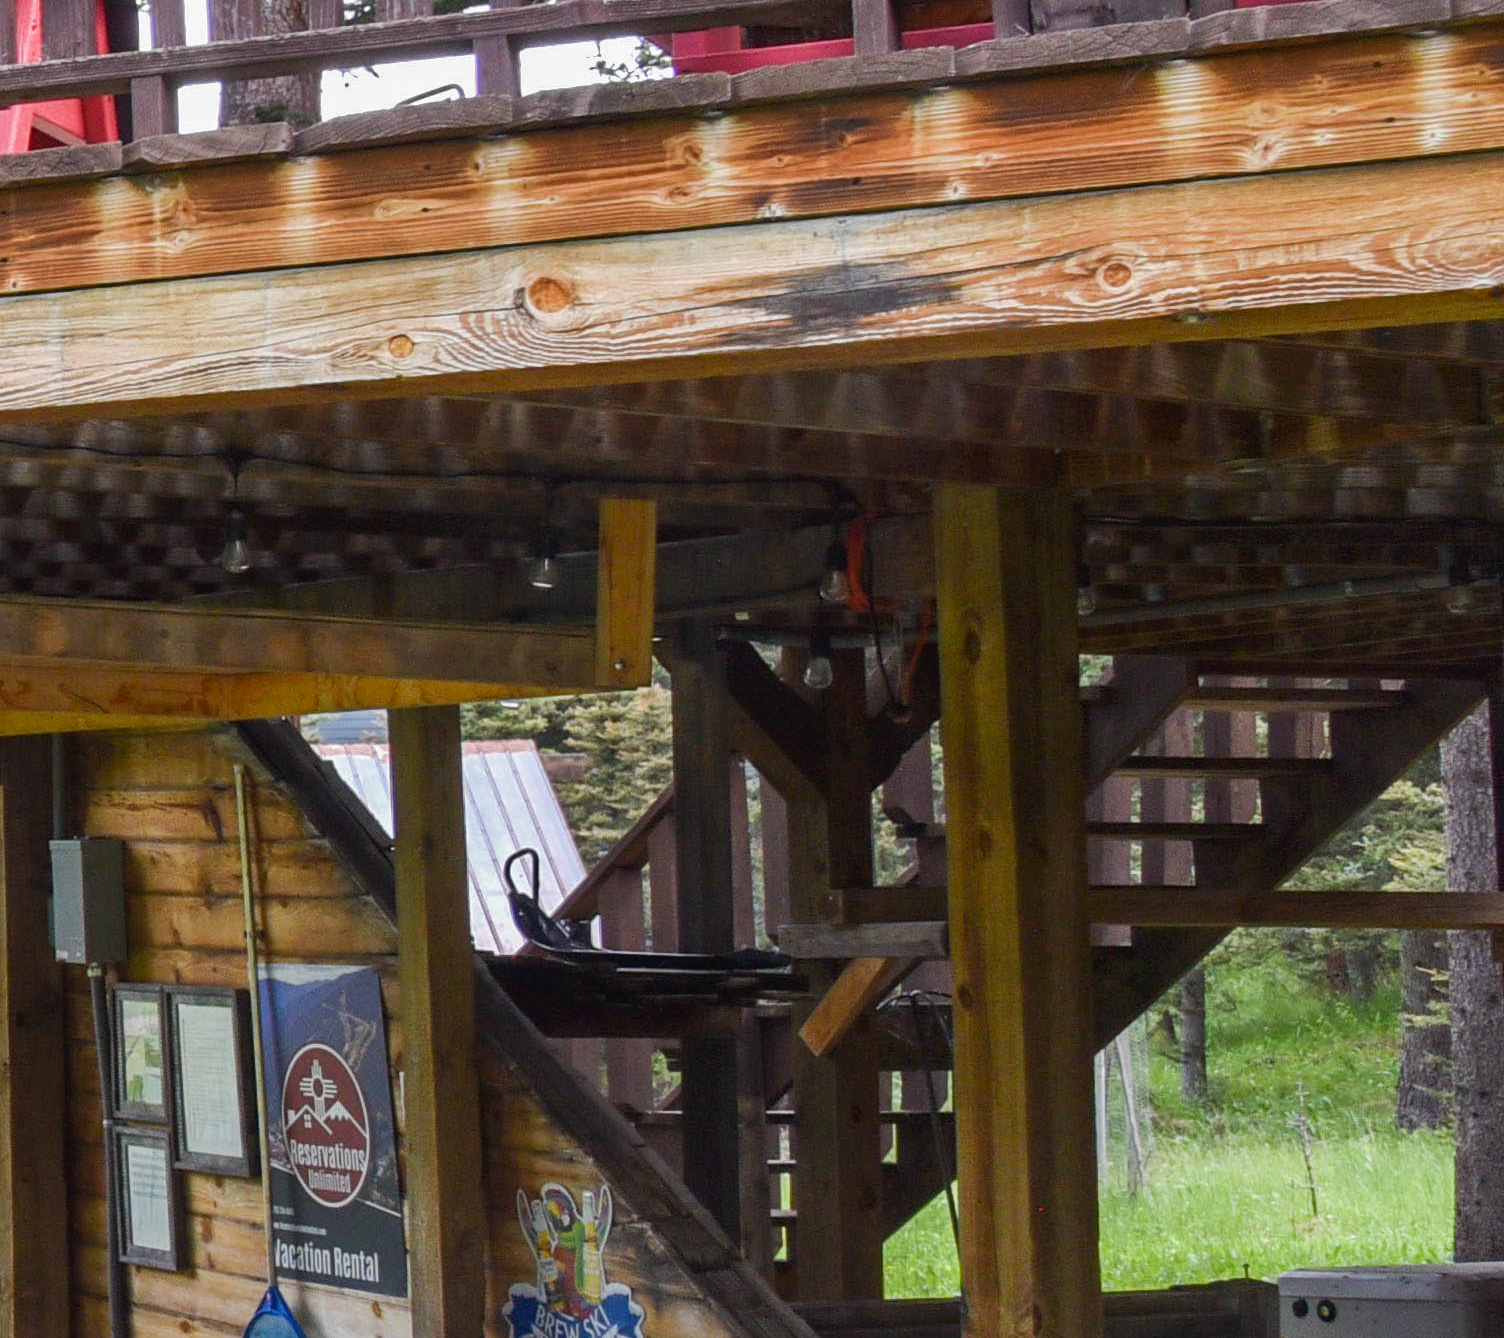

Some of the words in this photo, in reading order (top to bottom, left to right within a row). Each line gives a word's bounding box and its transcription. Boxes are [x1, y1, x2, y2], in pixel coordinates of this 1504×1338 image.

[290, 1139, 366, 1171] Reservations
[308, 1169, 351, 1193] Unlimited
[333, 1247, 379, 1282] Rental
